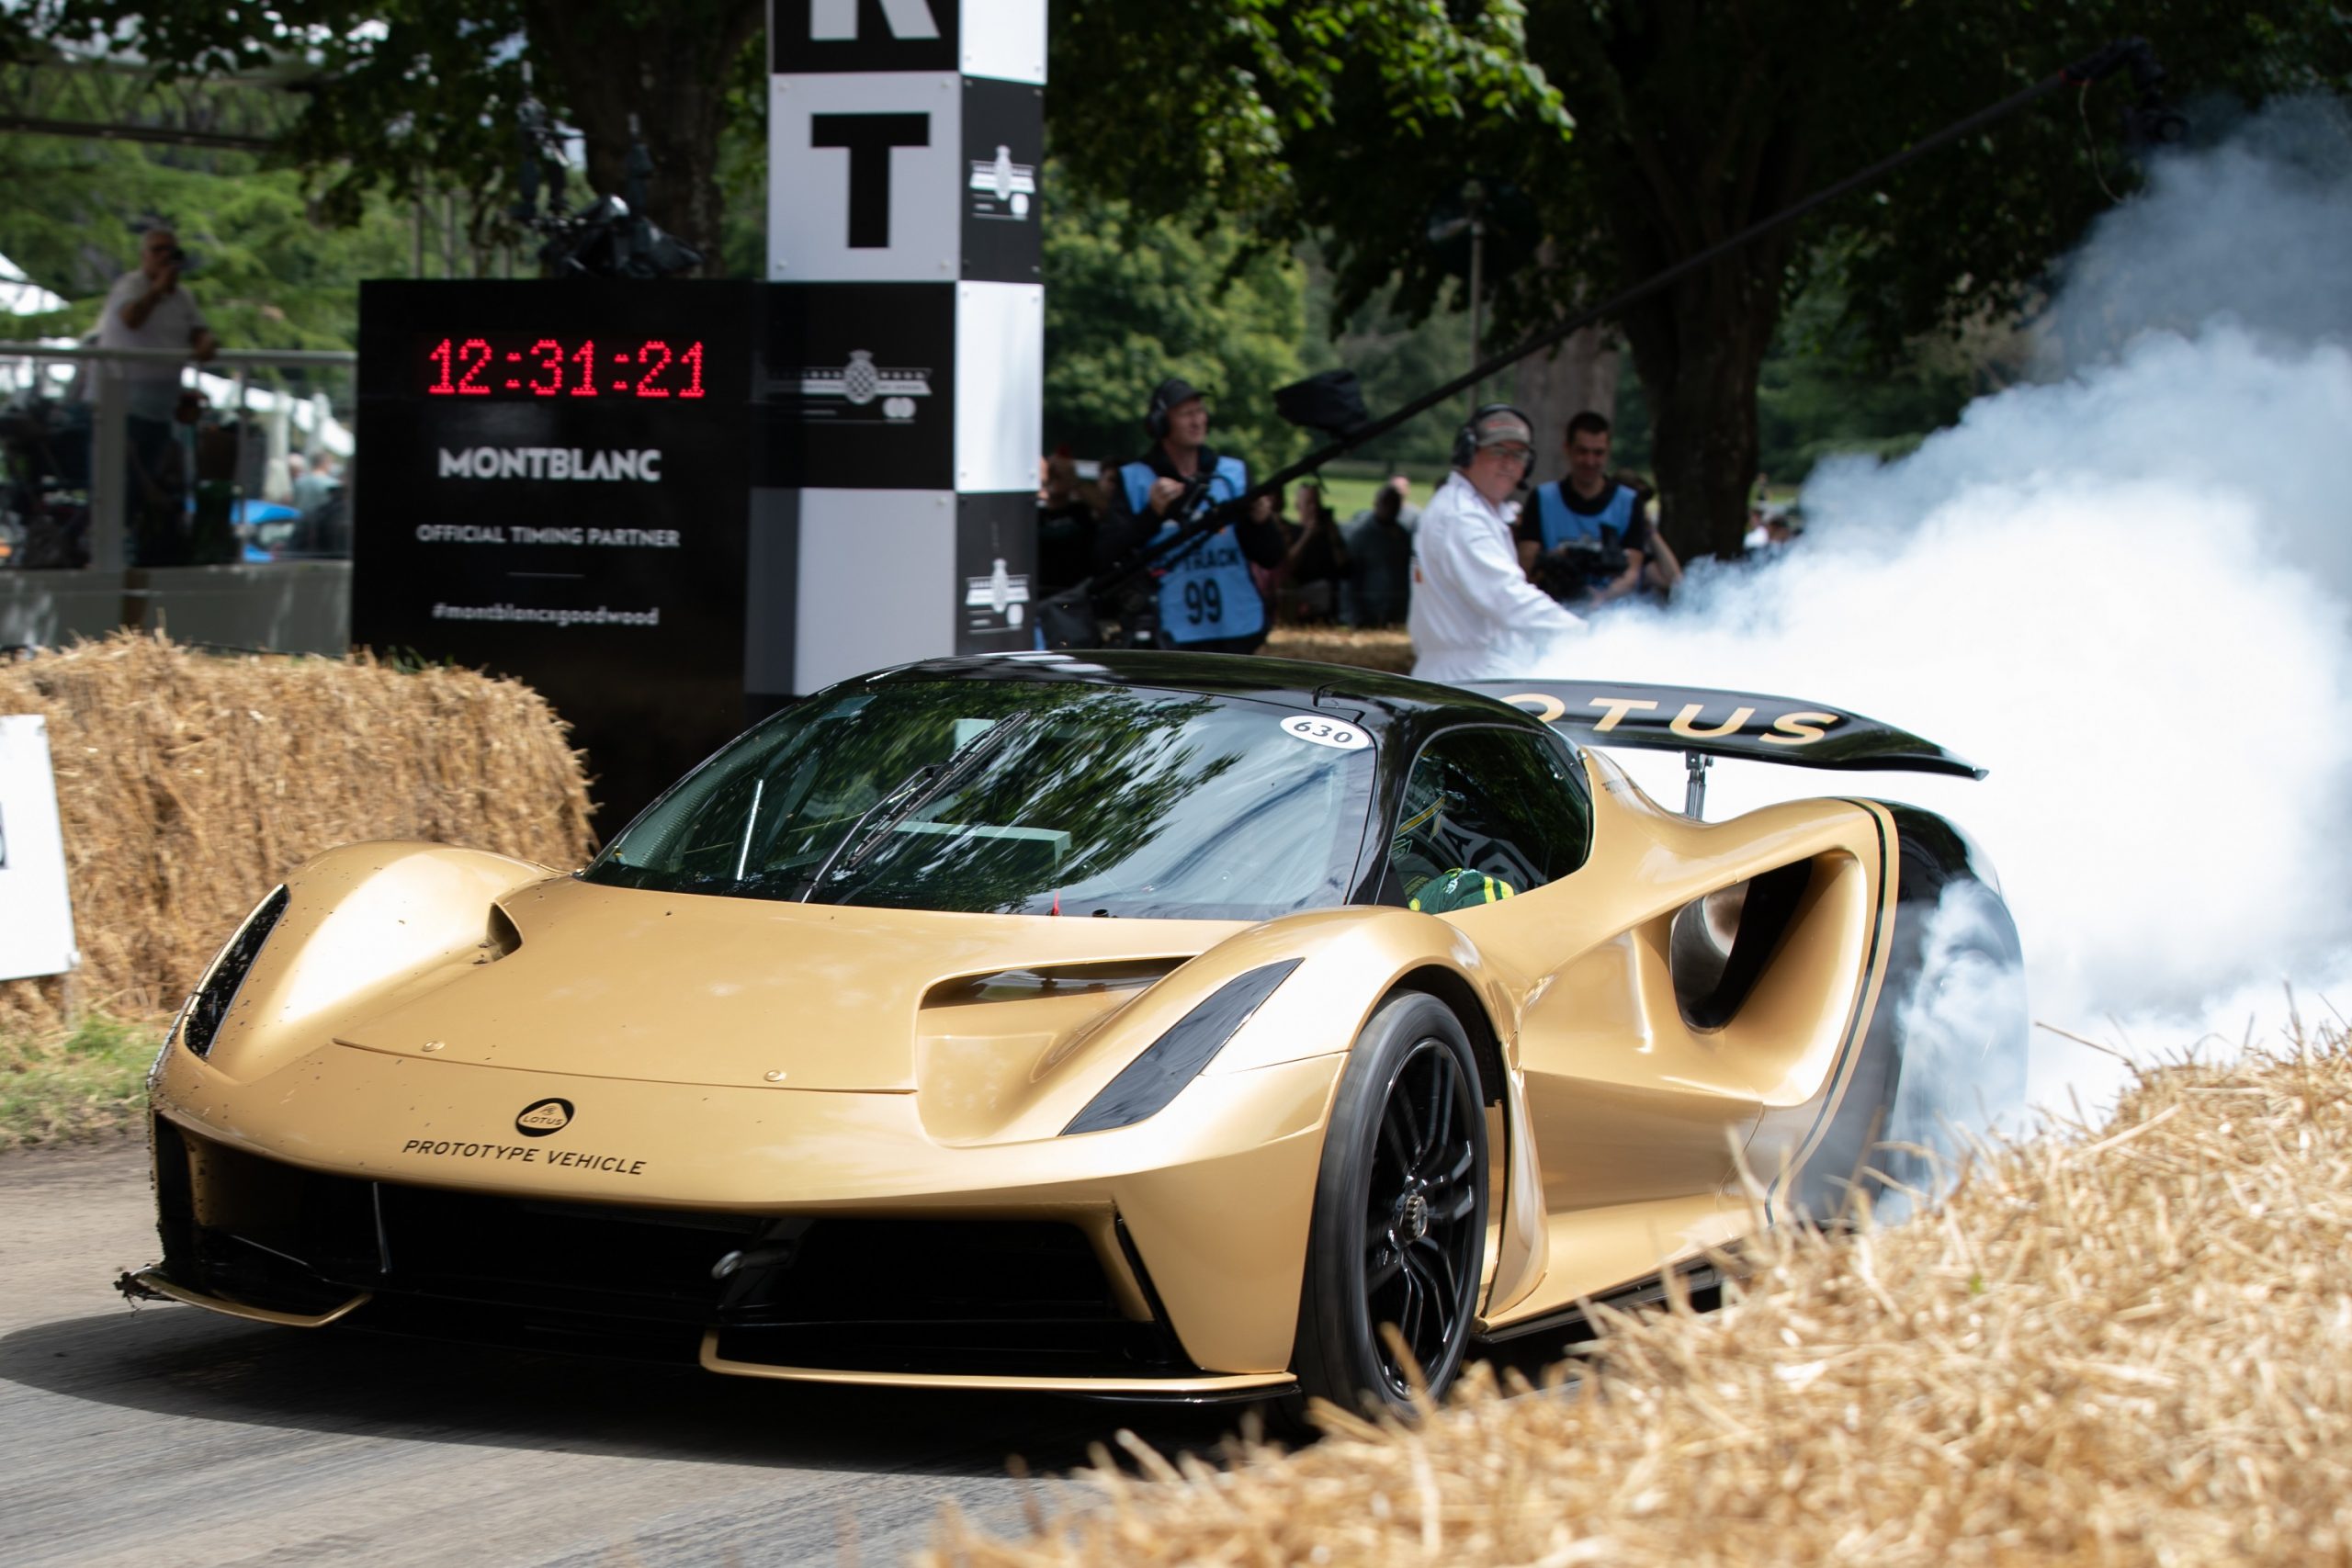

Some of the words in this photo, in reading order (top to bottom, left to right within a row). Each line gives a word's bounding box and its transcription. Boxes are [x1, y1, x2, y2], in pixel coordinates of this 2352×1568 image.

[428, 338, 705, 398] 12:31:21
[438, 446, 662, 482] MONTBLANC
[416, 524, 506, 543] OFFICIAL
[509, 525, 583, 545] TIMING
[587, 527, 681, 547] PARTNER
[1185, 578, 1222, 625] 99
[1294, 721, 1352, 743] 630
[522, 1115, 564, 1126] LOTUS
[402, 1140, 539, 1162] PROTOTYPE
[548, 1150, 647, 1175] VEHICLE
